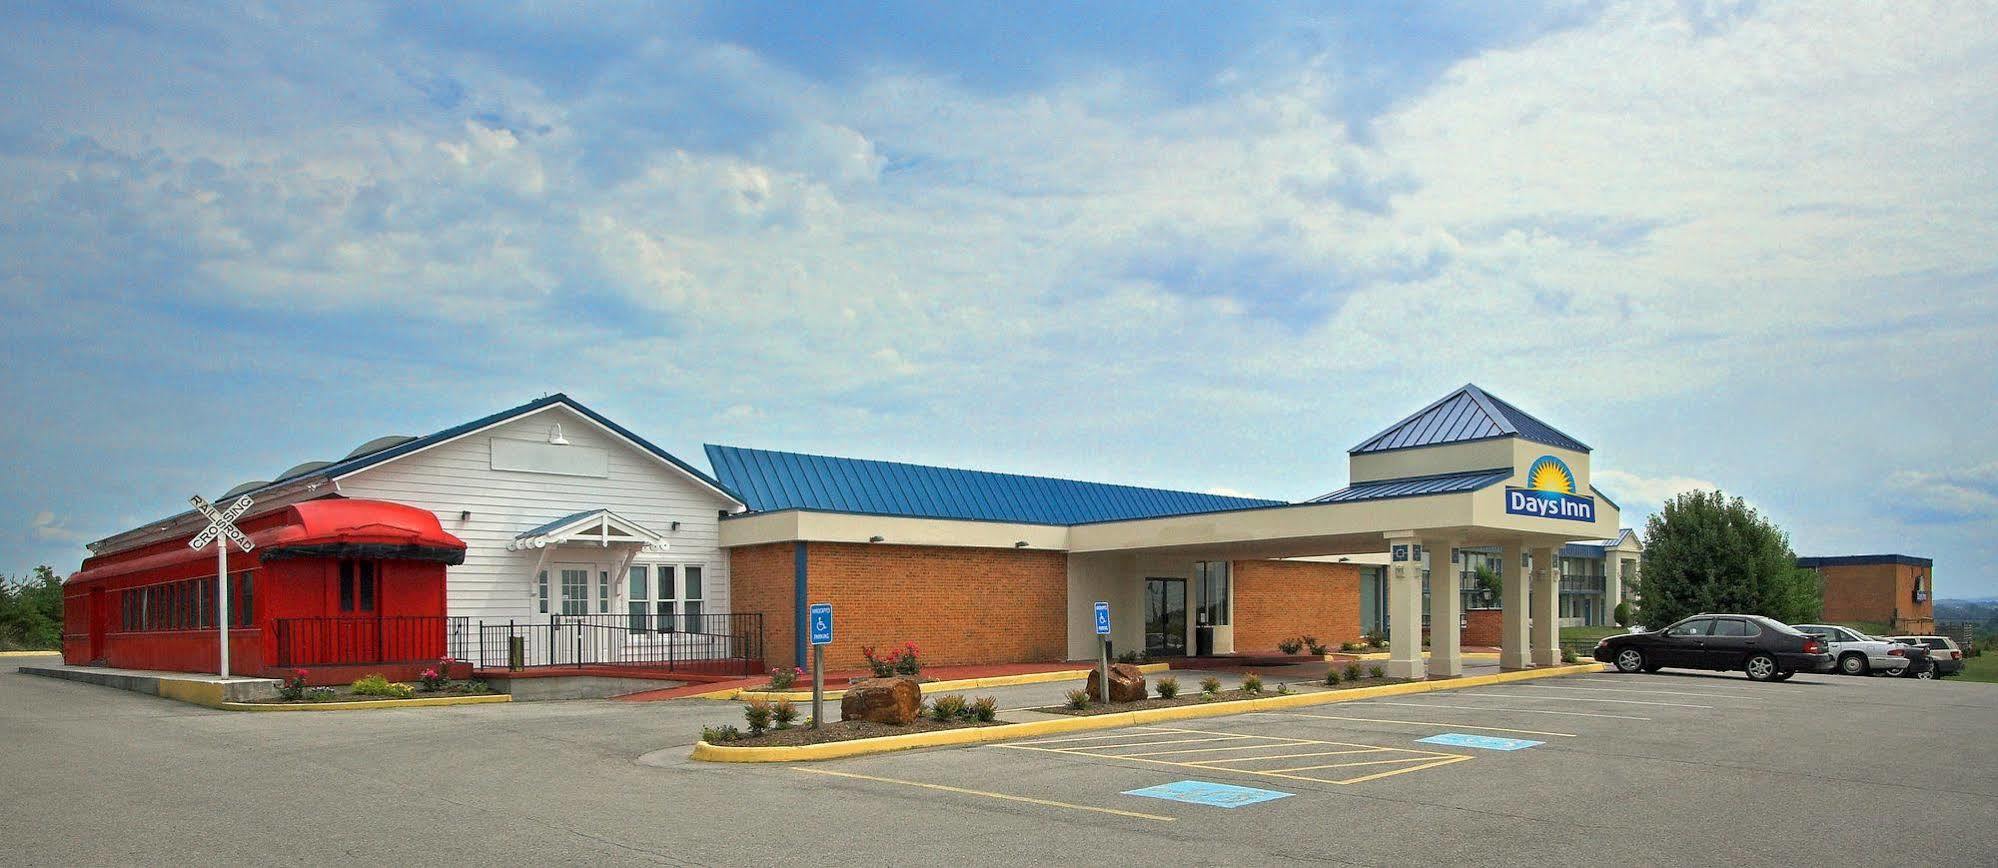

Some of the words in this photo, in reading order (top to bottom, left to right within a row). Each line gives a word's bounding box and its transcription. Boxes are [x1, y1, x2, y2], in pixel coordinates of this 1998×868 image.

[193, 497, 251, 549] CROSSING
[1511, 491, 1559, 516] Days
[1560, 497, 1591, 518] Inn
